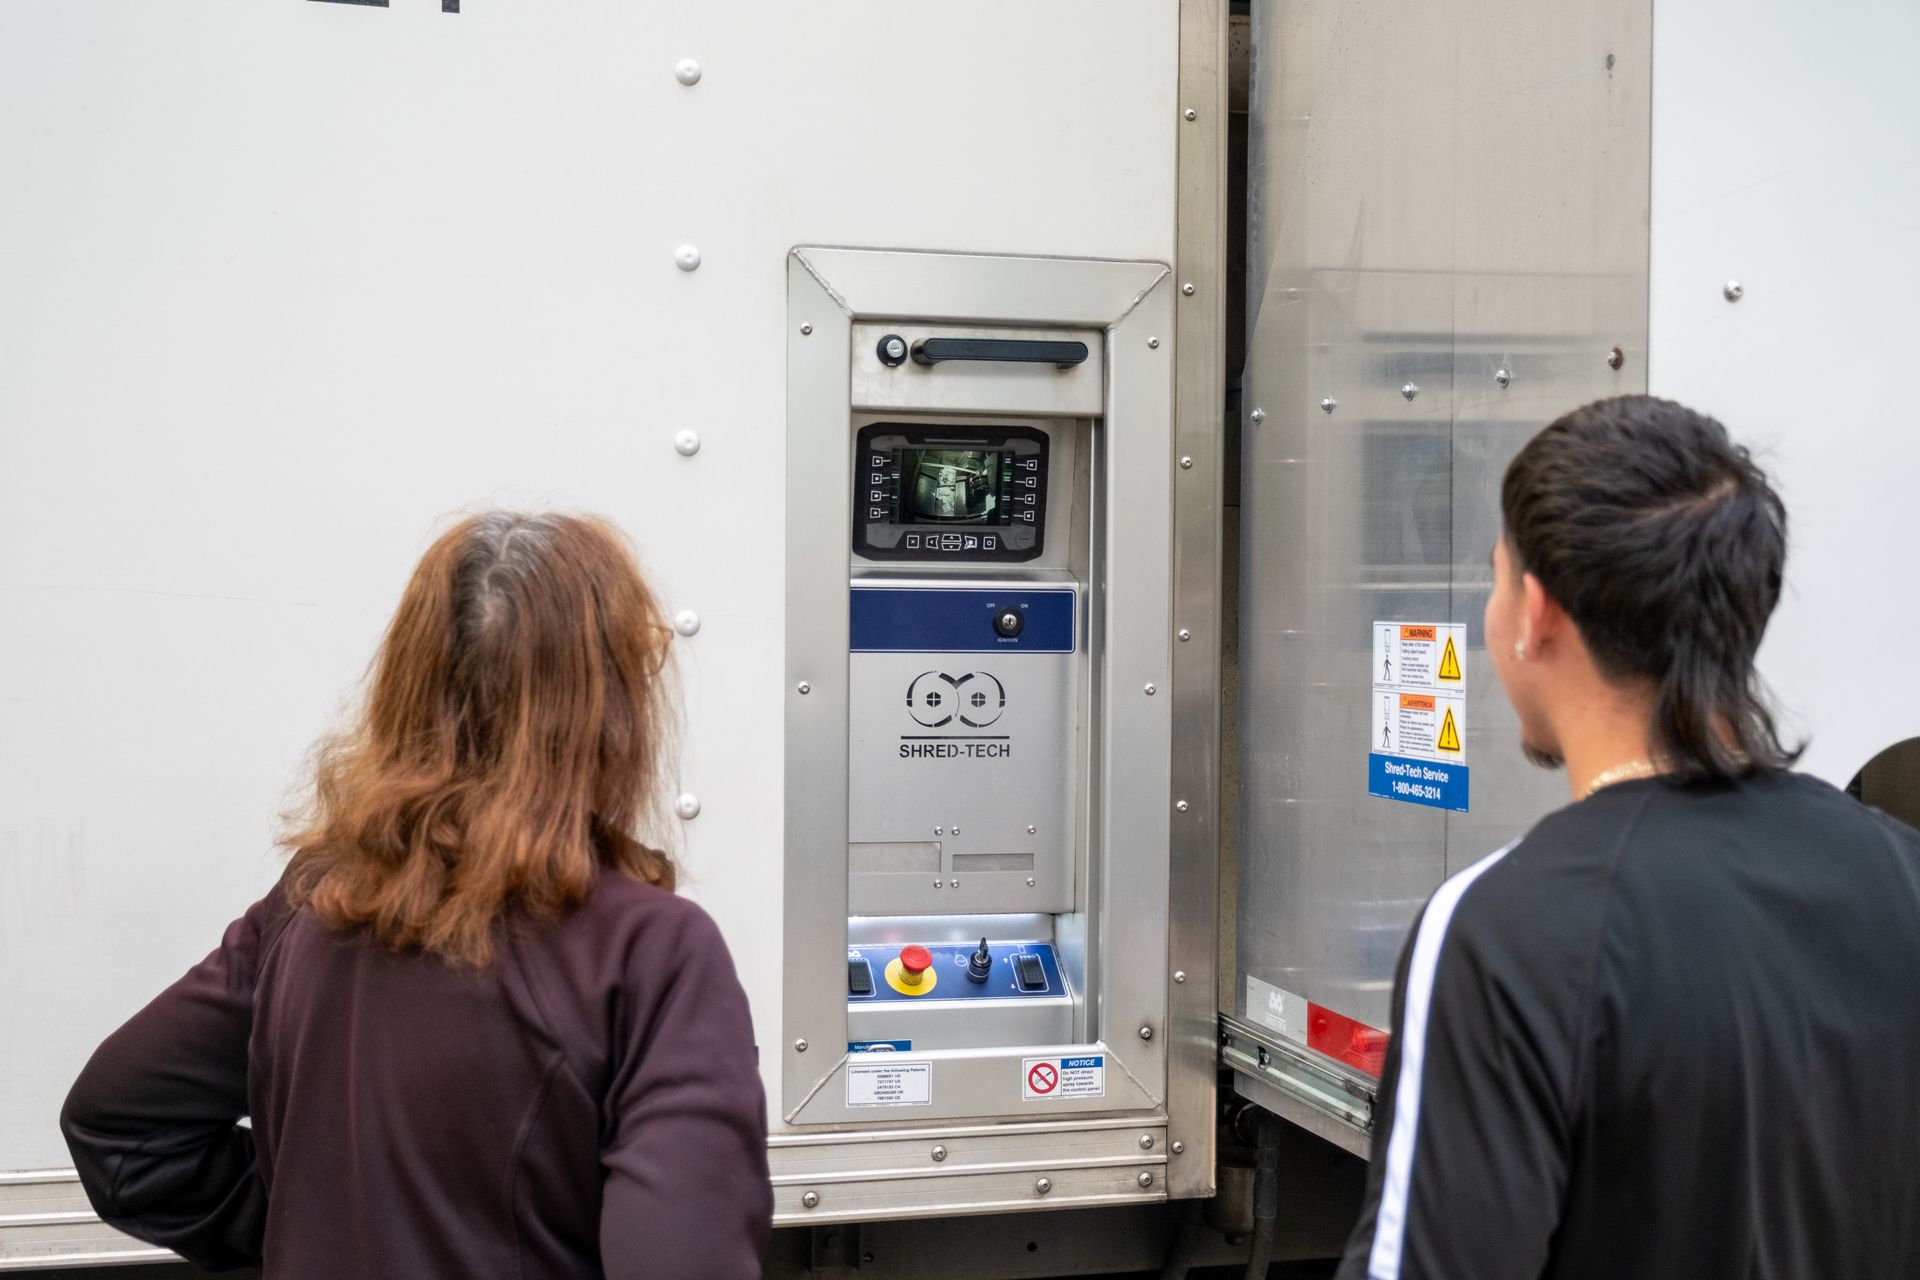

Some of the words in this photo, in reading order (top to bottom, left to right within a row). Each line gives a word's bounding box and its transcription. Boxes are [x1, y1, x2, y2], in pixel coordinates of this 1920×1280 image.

[1409, 628, 1433, 639] WARNING
[899, 744, 1010, 758] SHRED-TECH
[1384, 761, 1422, 779] Shred-Tech
[1423, 767, 1449, 783] Service
[1392, 781, 1441, 800] 1-800-465-3214
[1068, 1059, 1095, 1067] NOTICE
